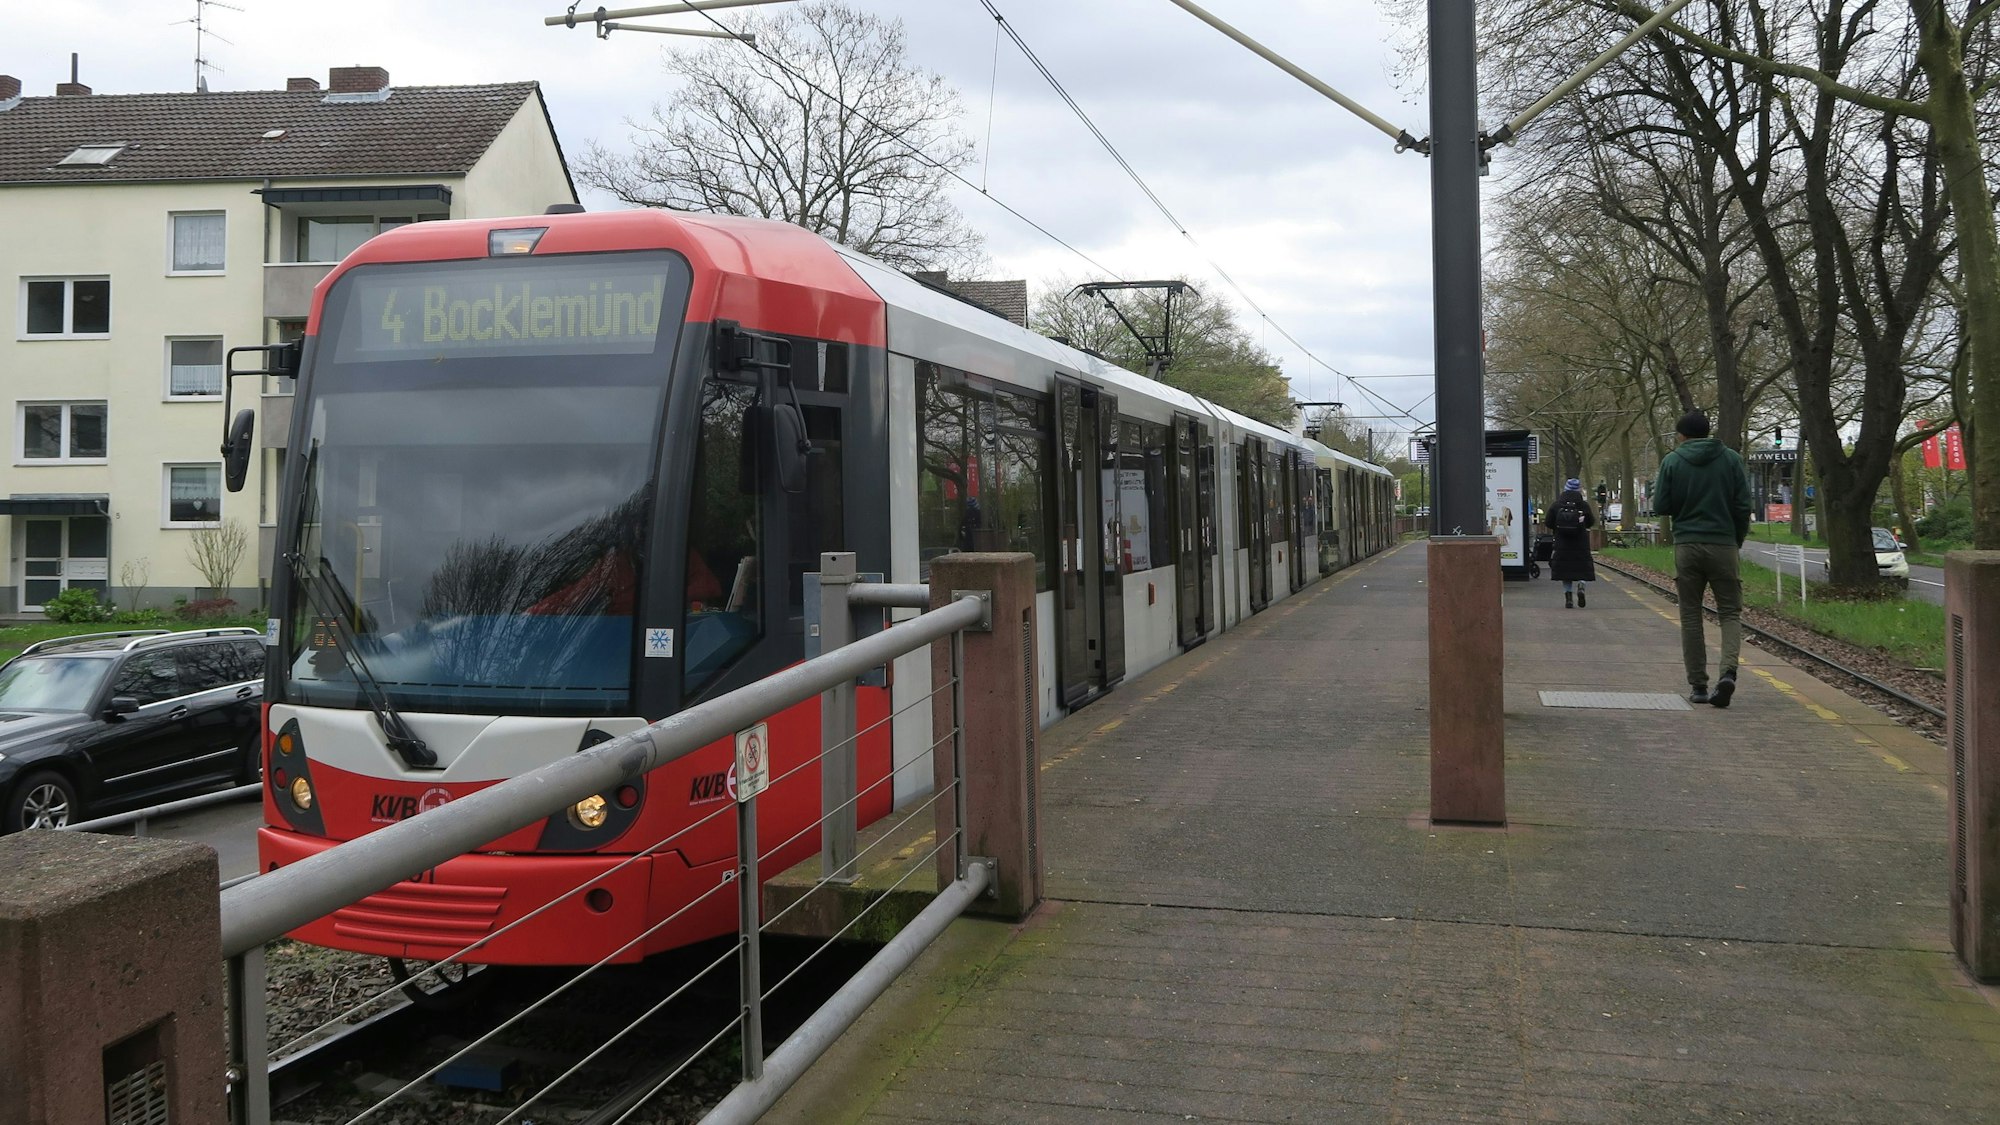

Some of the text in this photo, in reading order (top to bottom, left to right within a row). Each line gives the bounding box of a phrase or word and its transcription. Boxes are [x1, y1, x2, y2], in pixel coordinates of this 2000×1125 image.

[381, 276, 662, 343] 4 Bocklemünd
[690, 773, 726, 800] KVB
[372, 794, 417, 819] KVB
